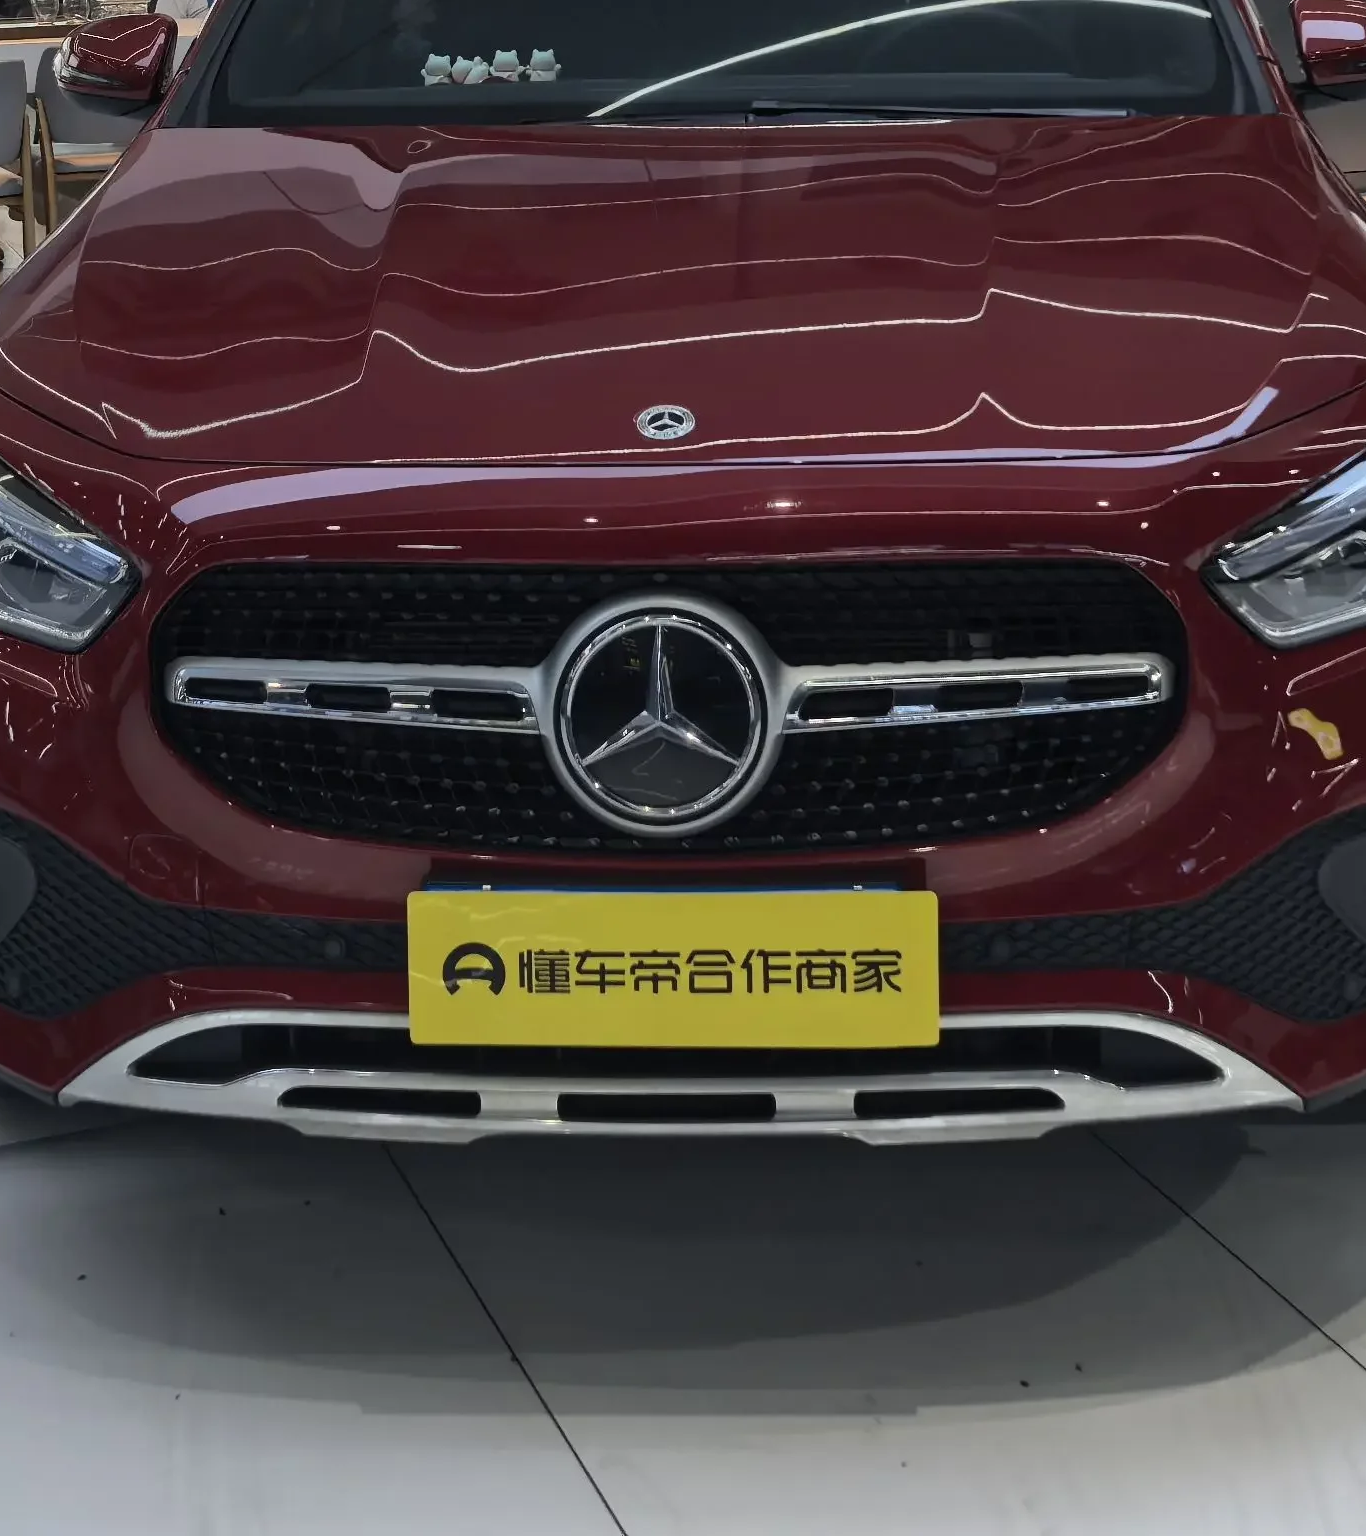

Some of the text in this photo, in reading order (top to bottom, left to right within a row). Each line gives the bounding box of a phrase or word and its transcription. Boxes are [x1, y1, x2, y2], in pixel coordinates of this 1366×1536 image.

[518, 947, 902, 995] 懂车帝合作商家
